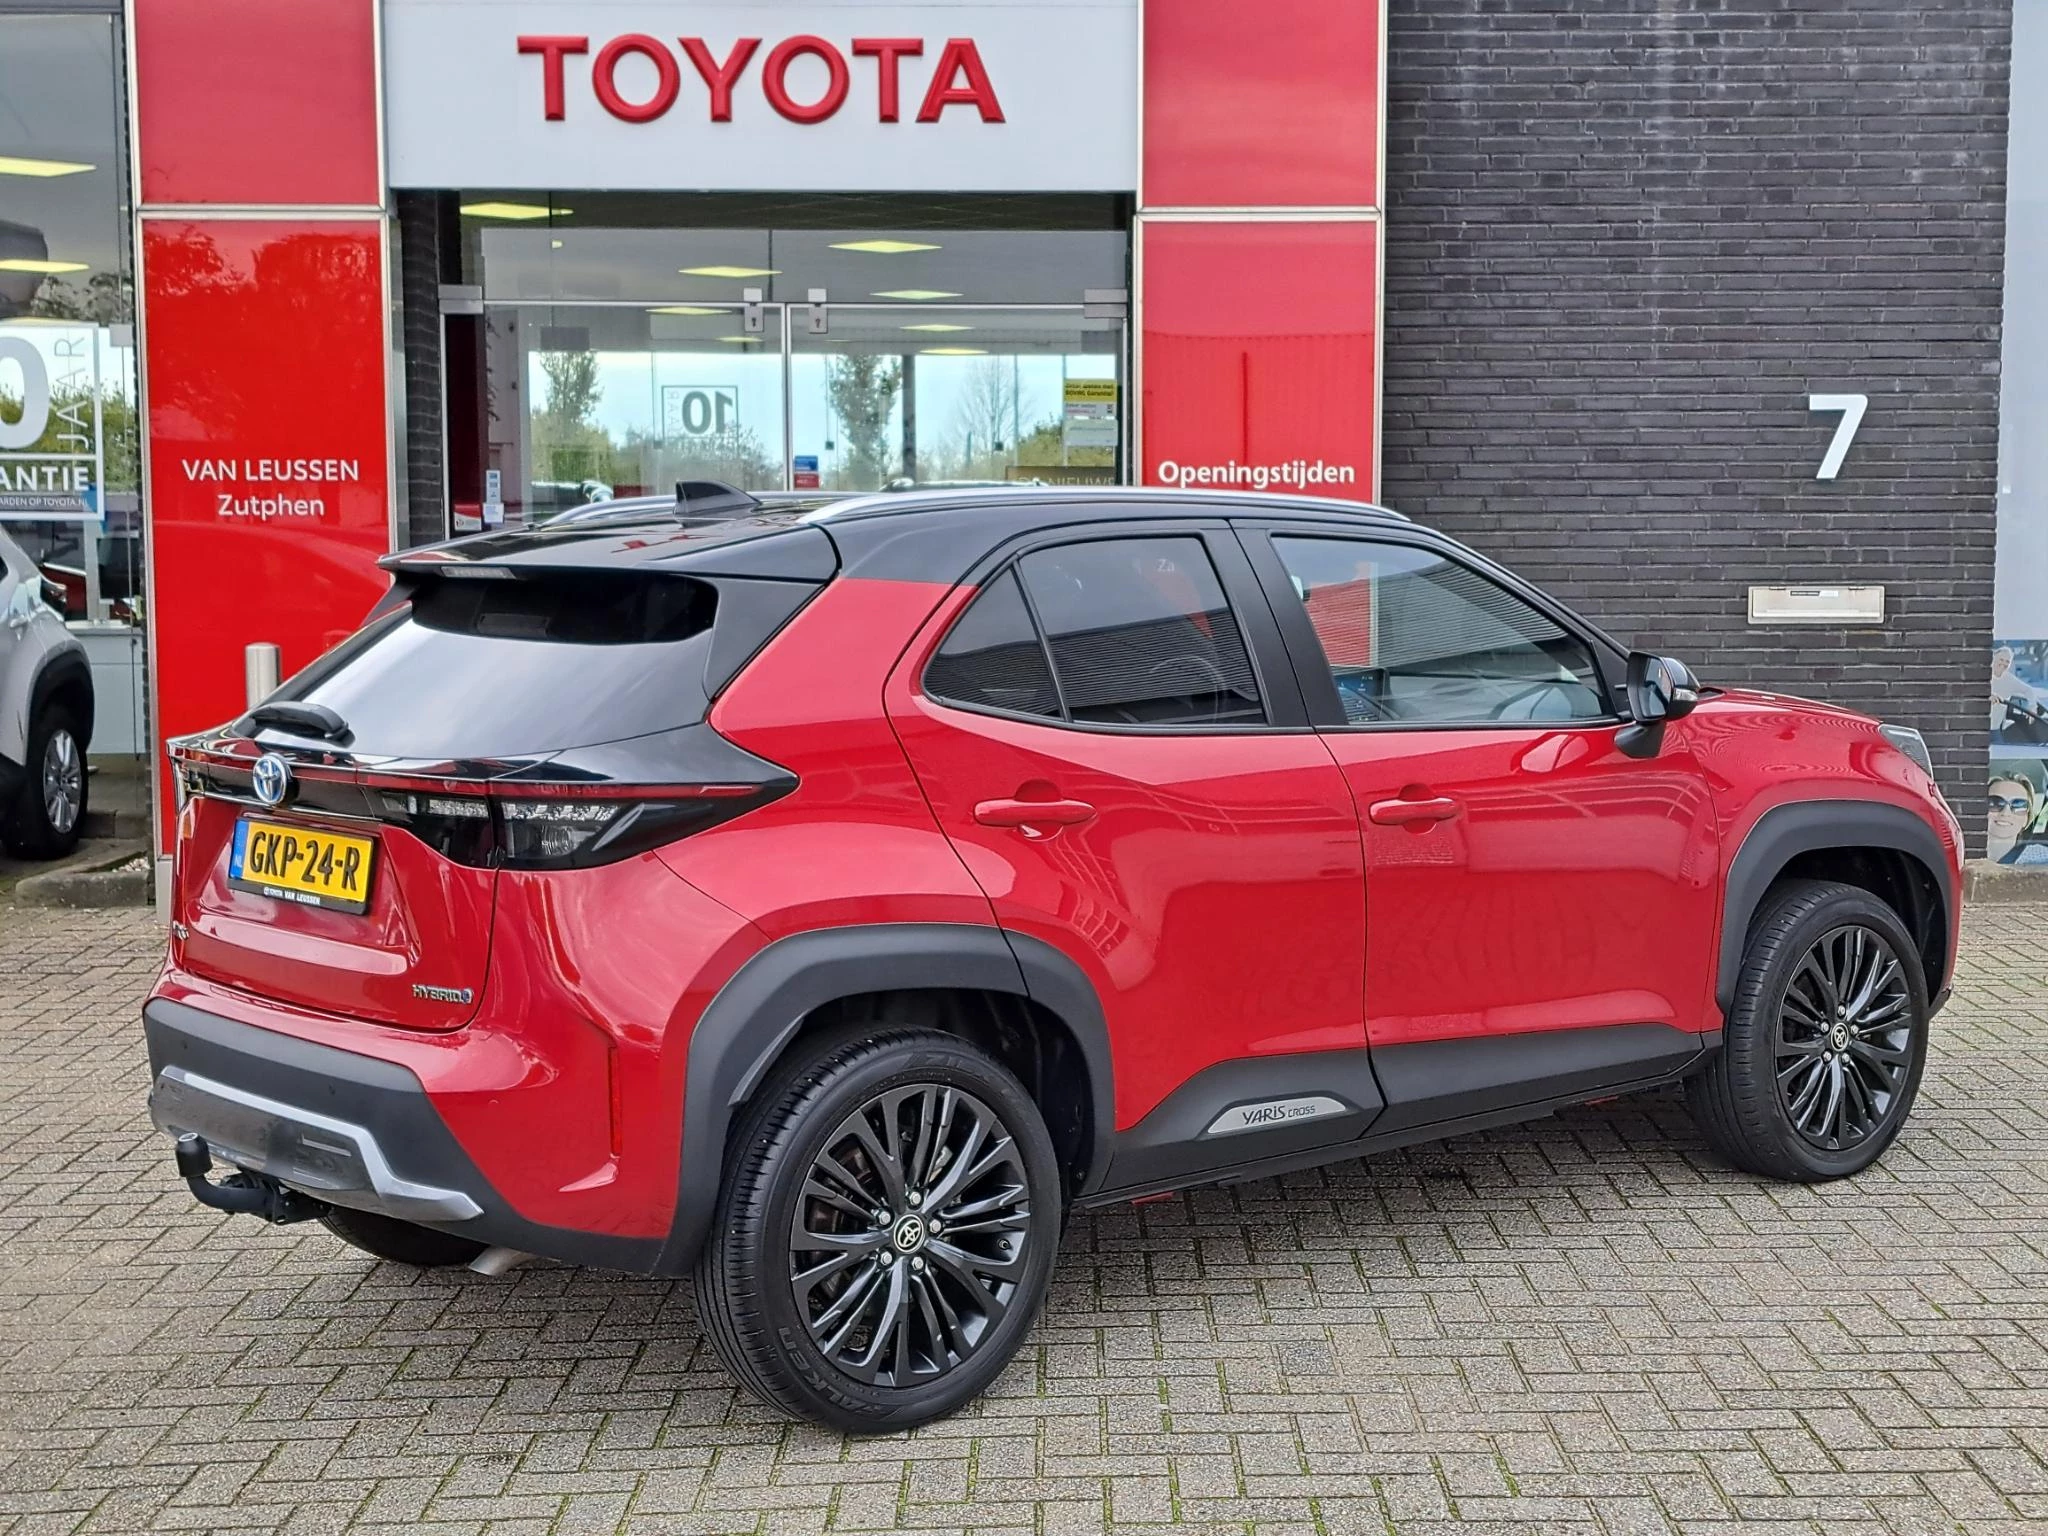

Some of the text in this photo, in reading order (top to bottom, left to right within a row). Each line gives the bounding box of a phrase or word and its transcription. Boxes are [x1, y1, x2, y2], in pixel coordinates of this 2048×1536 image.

[517, 33, 1006, 125] TOYOTA
[54, 337, 90, 450] JAAR
[1809, 394, 1868, 479] 7
[182, 459, 359, 481] VAN LEUSSEN
[1158, 460, 1355, 489] Openingstijden
[217, 493, 325, 521] Zutphen
[250, 831, 360, 891] GKP-24-R
[1243, 1105, 1316, 1125] YARIS CROSS
